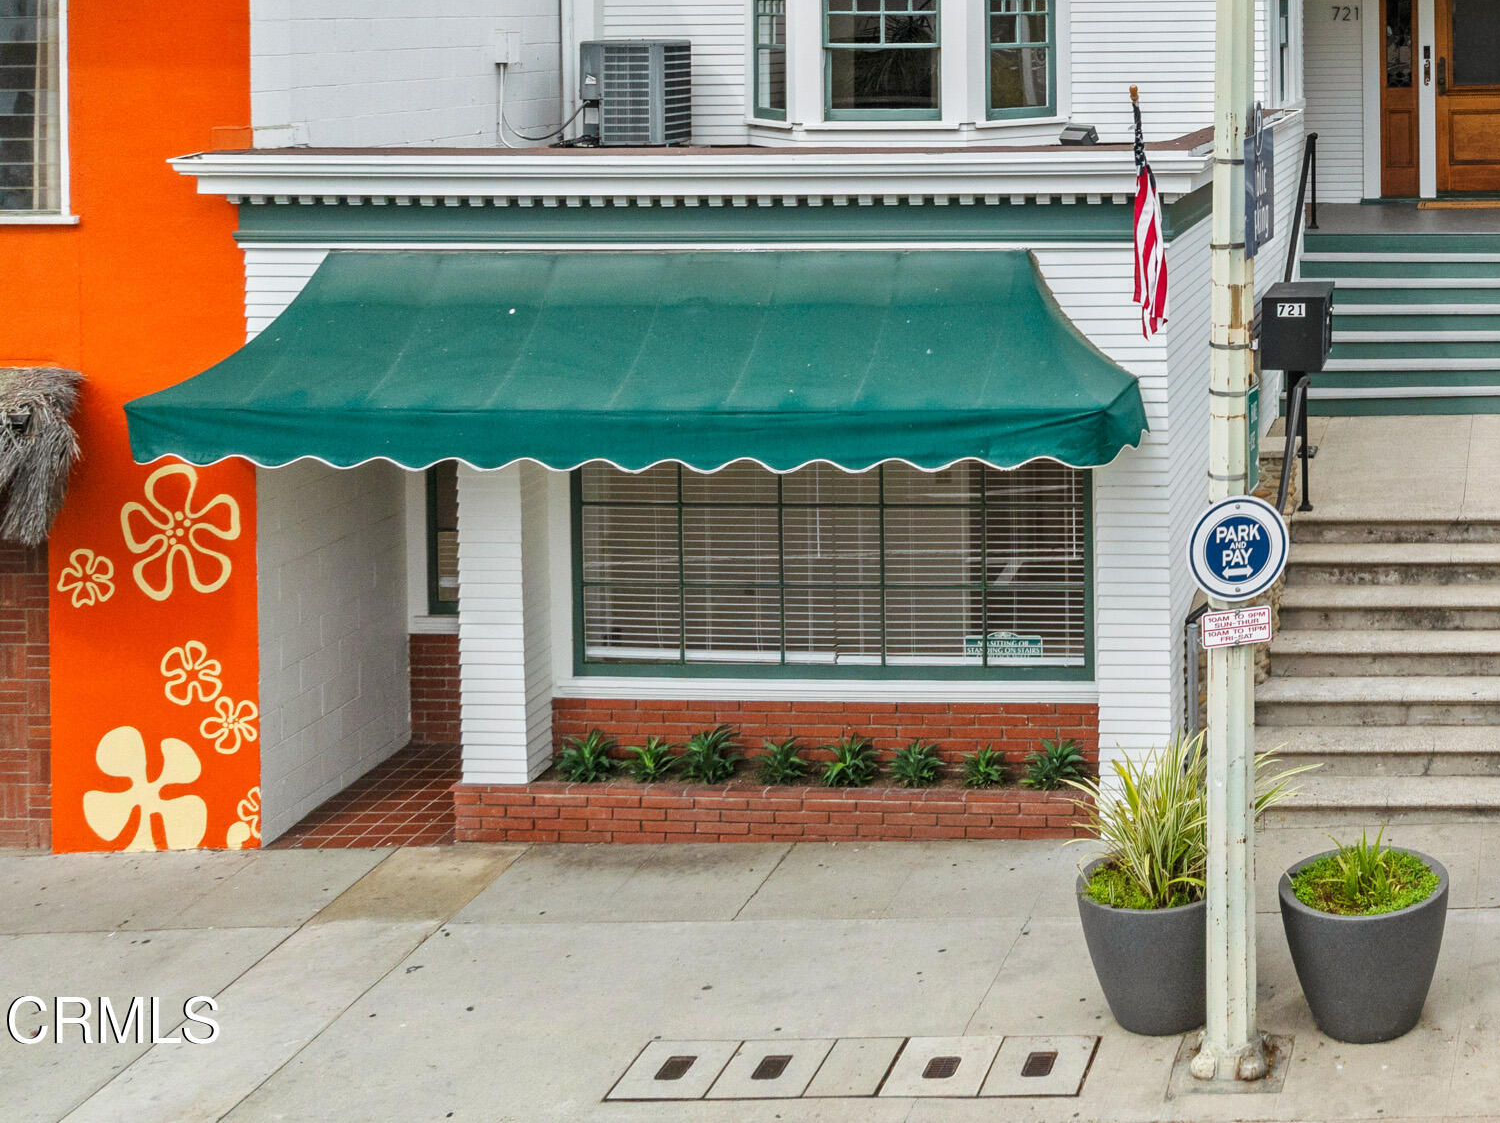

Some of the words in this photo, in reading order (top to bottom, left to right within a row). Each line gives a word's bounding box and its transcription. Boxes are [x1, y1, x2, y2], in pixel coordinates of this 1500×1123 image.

[1331, 5, 1359, 22] 721
[1278, 304, 1303, 316] 721
[1215, 523, 1261, 544] PARK
[1229, 540, 1247, 550] AND
[1222, 547, 1253, 567] PAY
[1208, 615, 1230, 623] 10AM
[1214, 618, 1259, 628] SUN-THUR
[1220, 633, 1253, 642] FRI-SAT
